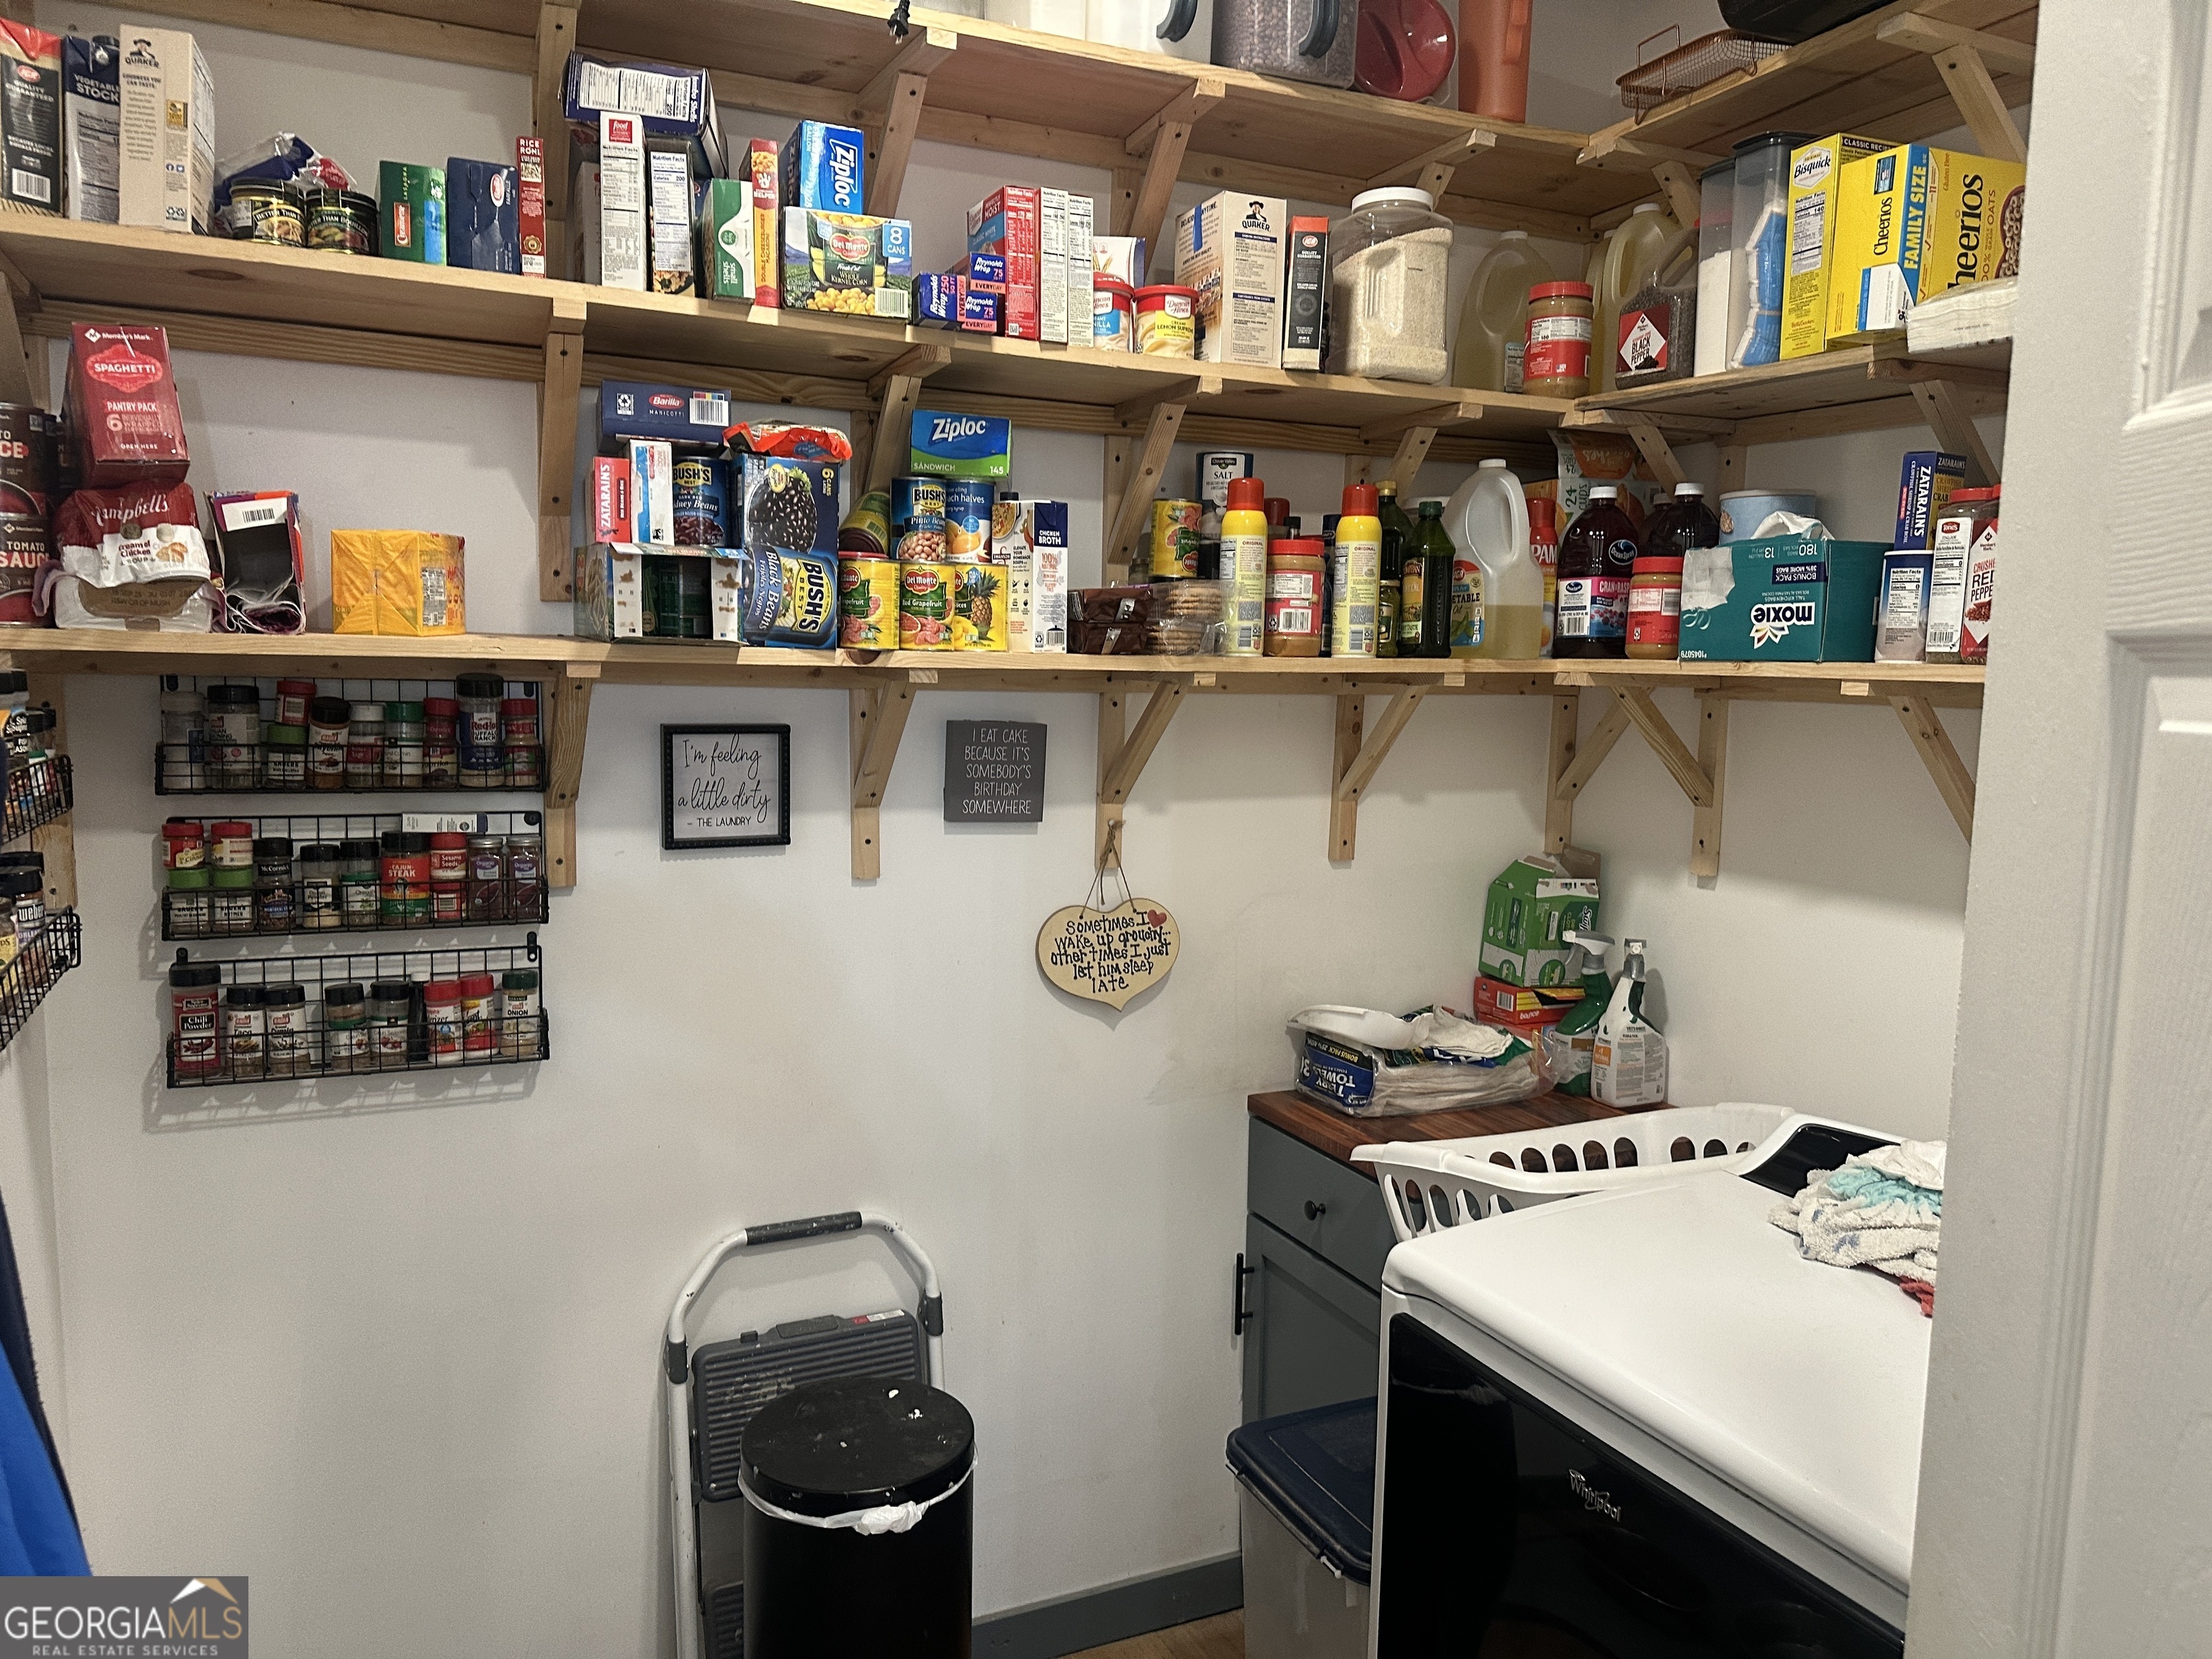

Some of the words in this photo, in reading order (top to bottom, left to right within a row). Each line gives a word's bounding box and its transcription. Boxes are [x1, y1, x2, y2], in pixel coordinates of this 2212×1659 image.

[125, 55, 161, 68] QUAKER
[76, 83, 120, 102] STOCK
[519, 138, 540, 148] RICE
[1843, 138, 1870, 150] CLASSIC
[1794, 156, 1831, 179] Bisquick
[830, 145, 856, 207] Ziploc
[1910, 166, 1926, 203] SIZE
[984, 201, 1001, 220] MOIST
[1987, 189, 1996, 224] OATS
[1241, 220, 1270, 233] QUAKER
[1874, 197, 1893, 256] Cheerios
[1948, 174, 1984, 289] heerios
[889, 227, 903, 245] 8
[1904, 206, 1923, 269] FAMILY
[845, 241, 868, 251] Monte
[887, 244, 906, 255] CANS
[974, 264, 991, 274] Wrap
[976, 257, 1003, 268] Reynolds
[994, 269, 1003, 277] 75
[941, 275, 950, 295] 250
[975, 282, 1002, 291] EVERYDAY
[930, 274, 938, 315] Reynolds
[966, 296, 994, 306] Reynolds
[938, 293, 948, 318] Wrap
[966, 302, 981, 313] Wrap
[1631, 335, 1651, 355] BLACK
[1631, 349, 1650, 366] PEPPER
[94, 363, 156, 374] SPAGHETTI
[107, 402, 136, 412] PANTRY
[138, 402, 157, 411] PACK
[652, 397, 680, 407] Barilla
[649, 409, 685, 418] MANICOTTI
[107, 413, 123, 431] 6
[932, 416, 986, 442] Ziploc
[822, 468, 834, 479] 6
[913, 461, 956, 472] SANDWICH
[989, 465, 1004, 475] 145
[673, 467, 711, 482] BUSH'S
[1213, 471, 1233, 480] SALT
[913, 487, 946, 503] BUSH'S
[960, 493, 985, 504] halves
[1933, 493, 1948, 502] CRAB
[693, 500, 719, 512] Beans
[910, 516, 930, 525] Pinto
[6, 541, 45, 552] TOMATO
[1038, 536, 1061, 545] BROTH
[1041, 552, 1058, 563] 100%
[1531, 544, 1558, 565] PAM
[1764, 547, 1775, 559] 13
[1799, 544, 1817, 556] 180
[765, 550, 780, 587] Black
[1776, 573, 1792, 582] PACK
[797, 562, 824, 632] BUSH'S
[1452, 593, 1480, 603] ETABLE
[1970, 585, 1993, 602] PEPPE
[912, 598, 943, 607] Grapefruit
[759, 590, 781, 632] Beans
[1753, 606, 1812, 623] moxie
[973, 728, 976, 742] I
[981, 728, 998, 742] EAT
[1002, 729, 1029, 744] CAKE
[683, 739, 707, 768] I'm
[709, 733, 762, 780] feeling
[964, 745, 1007, 761] BECAUSE
[1012, 747, 1030, 761] IT'S
[966, 763, 1032, 780] SOMEBODY'S
[974, 781, 1022, 797] BIRTHDAY
[678, 796, 688, 806] a
[691, 777, 729, 811] little
[732, 780, 771, 824] dirty
[962, 799, 1032, 814] SOMEWHERE
[697, 817, 713, 827] THE
[716, 816, 752, 827] LAUNDRY
[388, 868, 415, 878] STEAK
[19, 904, 44, 921] weber
[1136, 911, 1151, 927] I
[1097, 932, 1114, 949] up
[1050, 948, 1087, 966] other
[1130, 943, 1143, 958] I
[1143, 938, 1172, 961] just
[1073, 961, 1094, 980] let
[1123, 958, 1154, 976] sleep
[1519, 1010, 1539, 1020] bounce
[1340, 1051, 1359, 1064] BONUS
